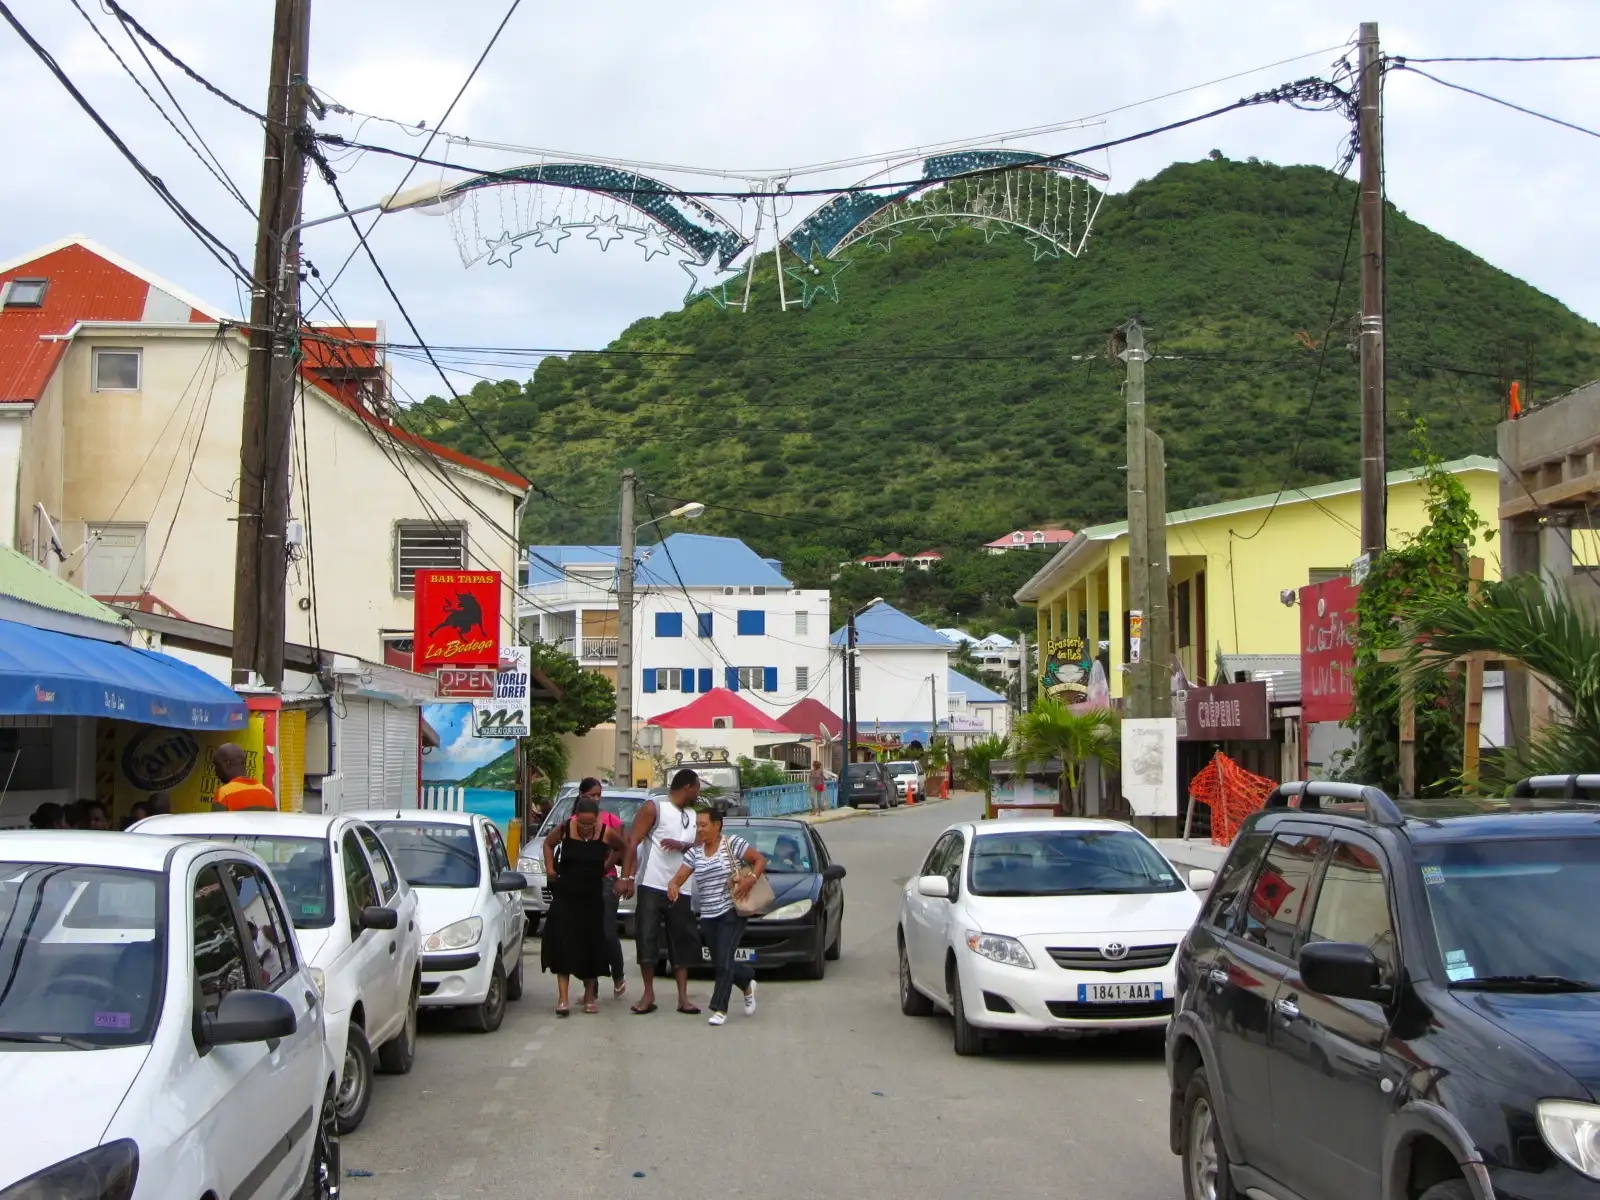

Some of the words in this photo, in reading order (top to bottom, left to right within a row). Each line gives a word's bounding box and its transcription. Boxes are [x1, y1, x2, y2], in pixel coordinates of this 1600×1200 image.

[431, 575, 454, 583] BAR
[457, 575, 494, 584] TAPAS
[425, 643, 442, 659] La
[443, 638, 493, 658] Bodega
[1047, 636, 1085, 655] Brasserie
[439, 671, 494, 688] OPEN
[1311, 659, 1337, 697] LIVE
[1198, 691, 1241, 728] CRÊPERIE
[1093, 985, 1151, 1000] 1841-AAA
